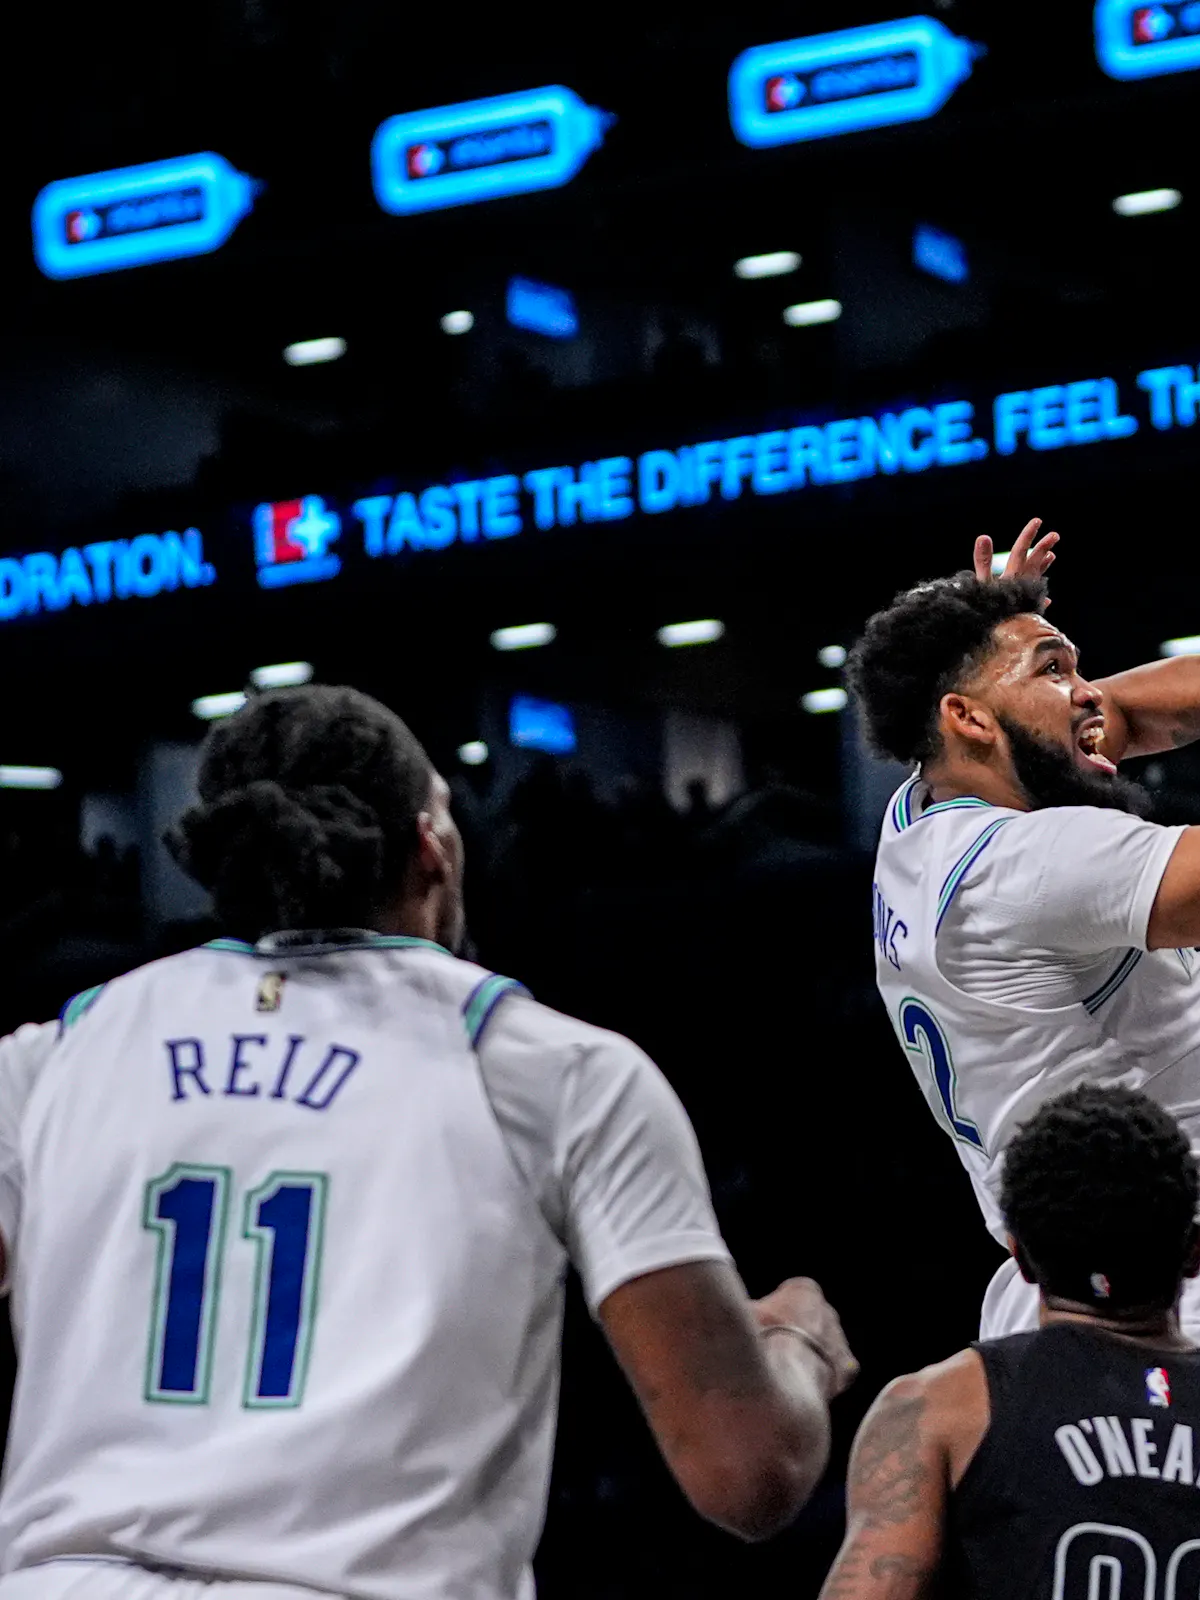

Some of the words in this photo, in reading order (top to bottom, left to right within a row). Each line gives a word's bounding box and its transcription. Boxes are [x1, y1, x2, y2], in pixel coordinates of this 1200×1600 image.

[353, 474, 523, 557] TASTE
[523, 455, 634, 531] THE
[638, 400, 989, 514] DIFFERENCE.
[993, 377, 1138, 456] FEEL
[165, 1033, 361, 1111] REID
[900, 996, 990, 1160] 2
[143, 1162, 329, 1412] 11
